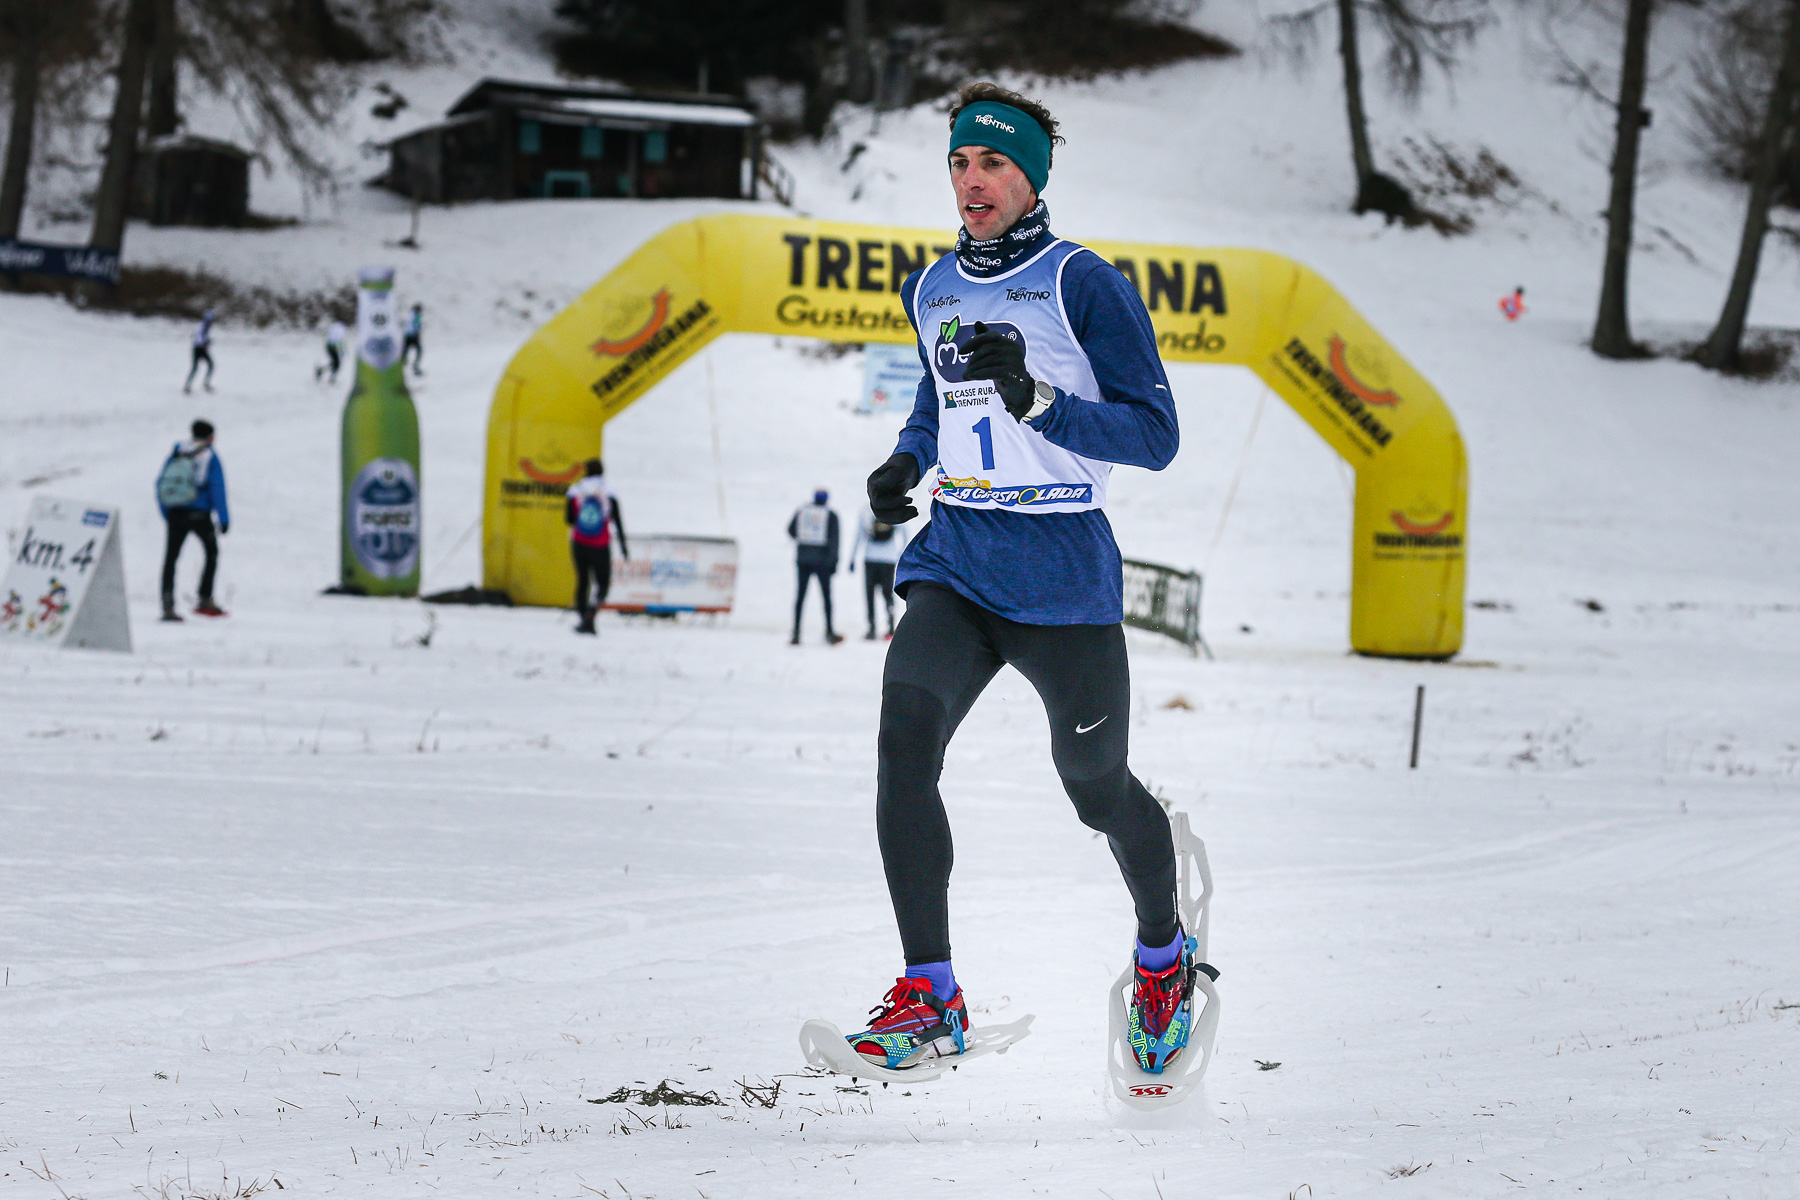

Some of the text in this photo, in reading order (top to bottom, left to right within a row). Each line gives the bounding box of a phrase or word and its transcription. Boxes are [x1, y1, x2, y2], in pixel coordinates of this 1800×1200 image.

[975, 115, 1015, 134] TRENTINO
[1010, 224, 1043, 240] TRENTINO
[1005, 287, 1051, 301] TRENTINO
[954, 387, 977, 399] CASSE
[956, 397, 989, 407] TRENTINE
[972, 416, 995, 470] 1
